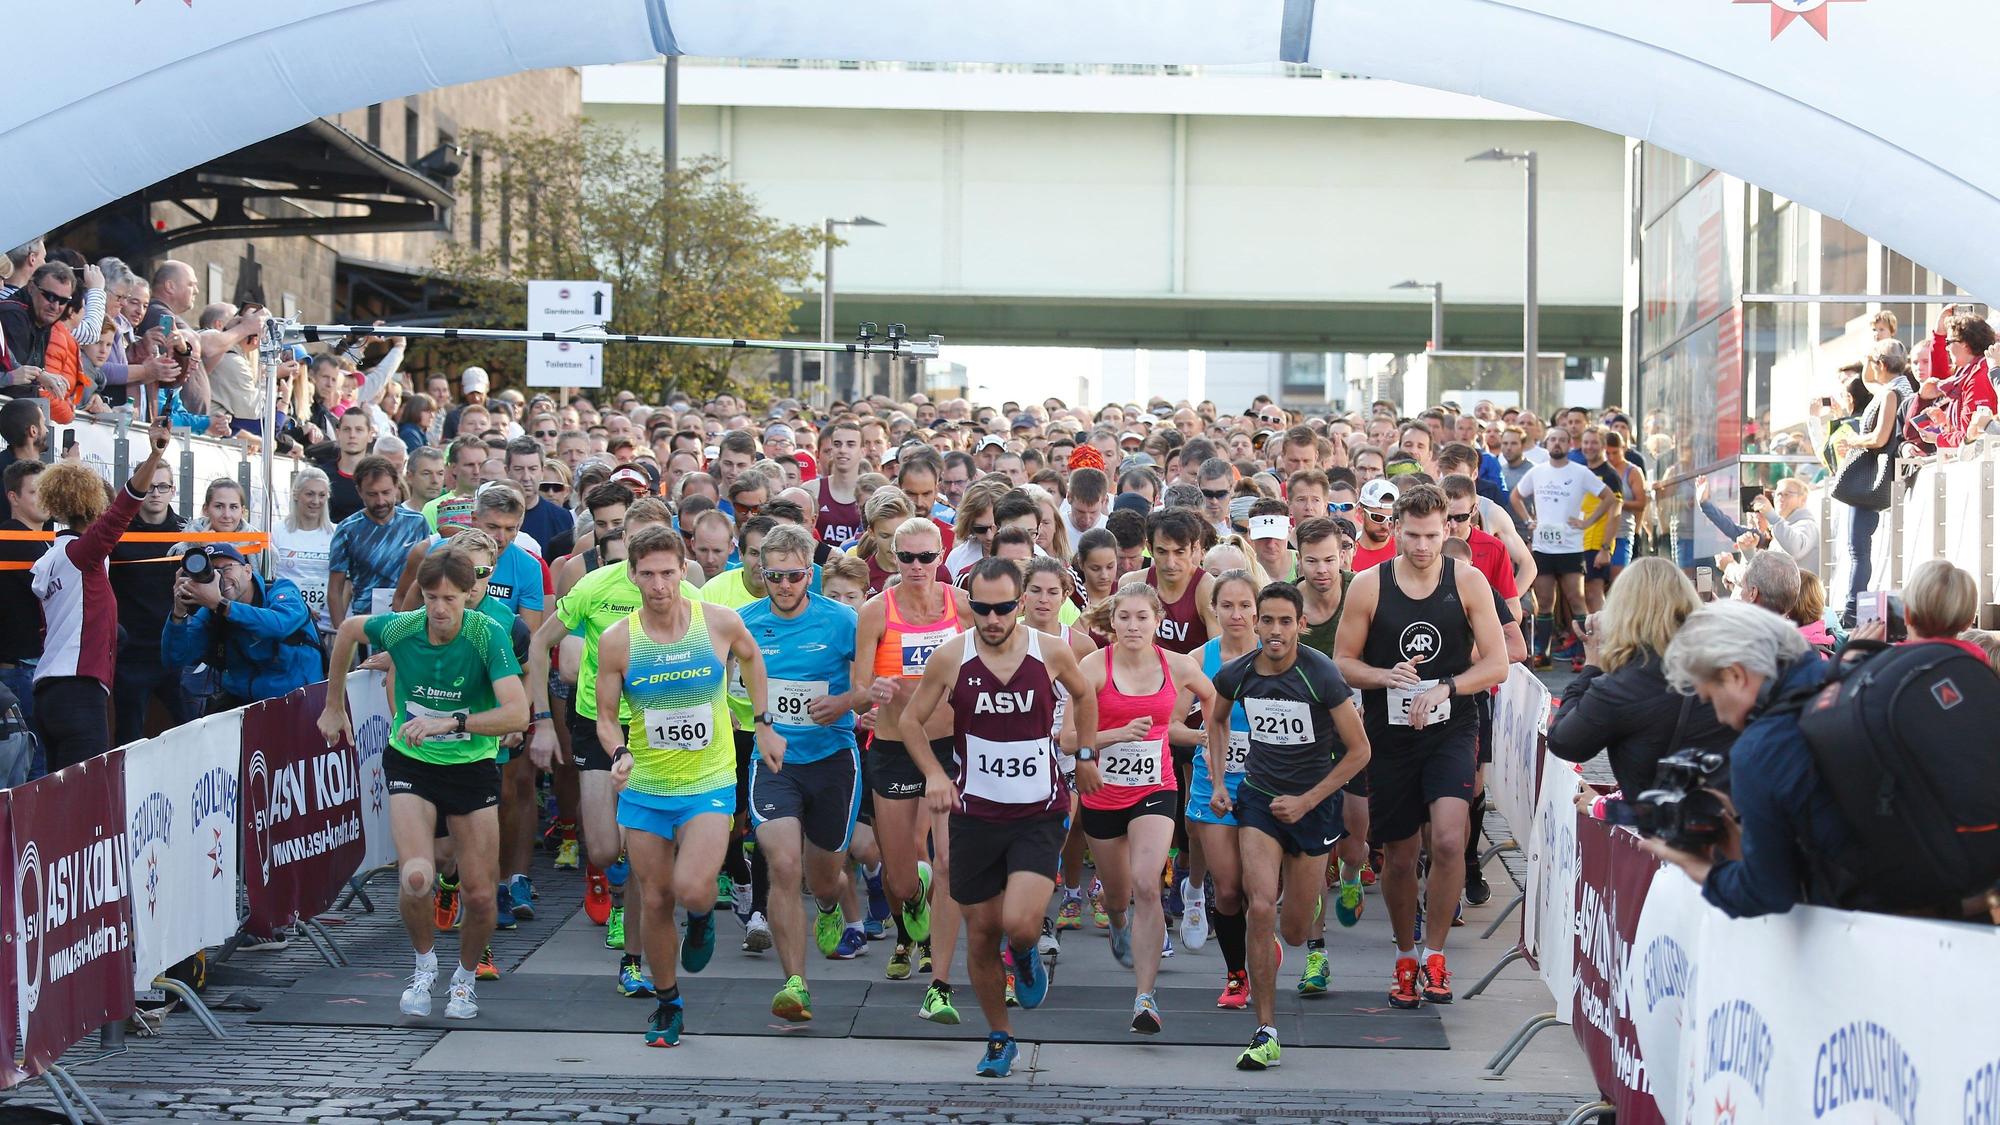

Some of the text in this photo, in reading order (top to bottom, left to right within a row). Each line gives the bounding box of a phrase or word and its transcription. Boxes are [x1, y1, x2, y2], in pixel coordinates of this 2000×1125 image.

[545, 360, 583, 368] Toiletten
[1539, 531, 1561, 541] 1615
[648, 666, 713, 684] BROOKS
[974, 689, 1035, 714] ASV
[654, 722, 707, 742] 1560
[1254, 715, 1304, 735] 2210
[978, 753, 1038, 778] 1436
[1105, 756, 1155, 776] 2249
[269, 759, 307, 826] ASV
[46, 825, 128, 933] ASV KÖLN
[1813, 1020, 1920, 1125] GEROLSTEINER
